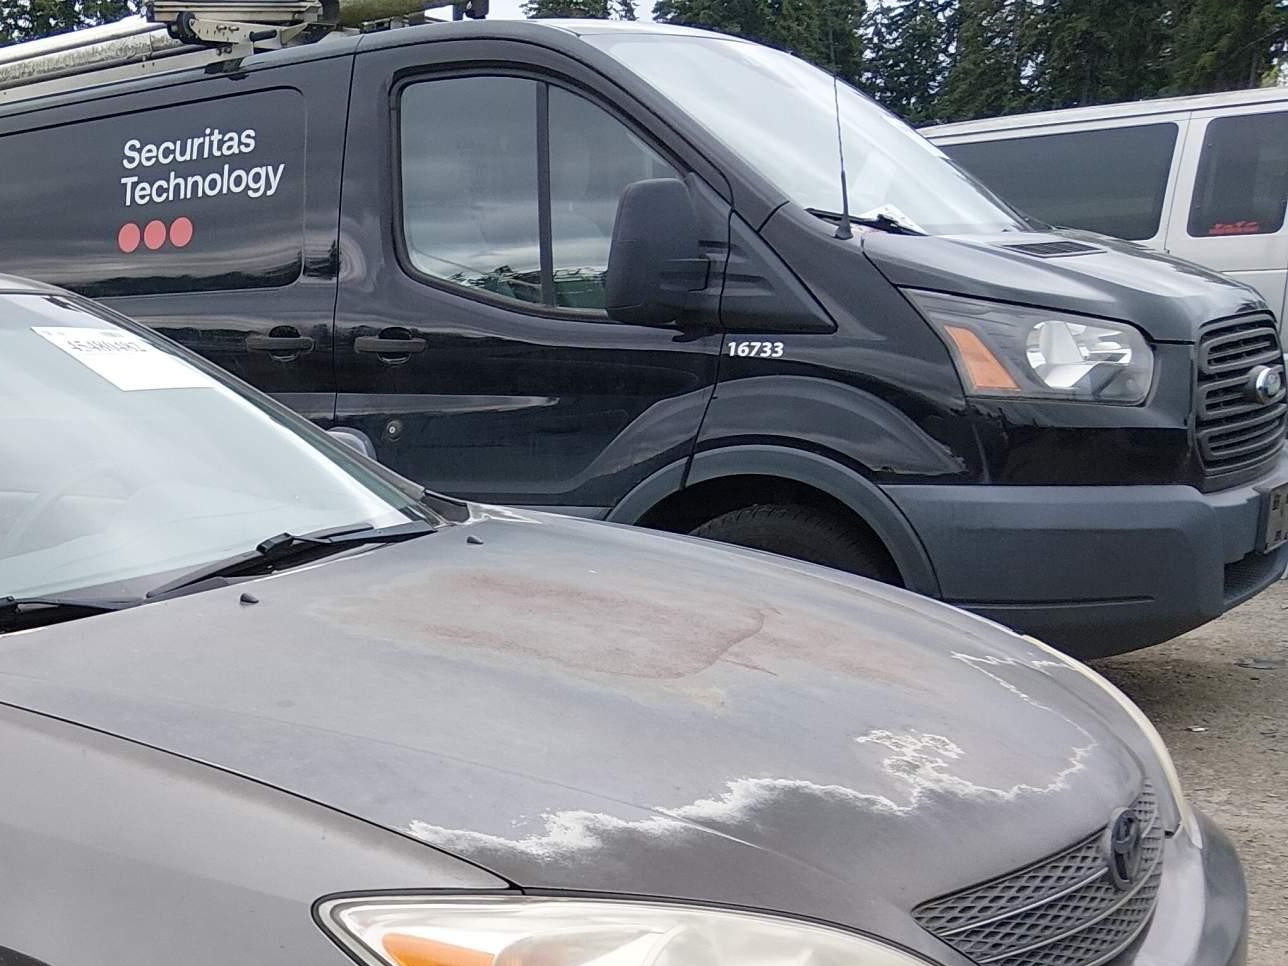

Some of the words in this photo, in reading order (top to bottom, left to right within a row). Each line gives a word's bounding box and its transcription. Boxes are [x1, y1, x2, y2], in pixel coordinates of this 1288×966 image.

[122, 127, 257, 169] Securitas
[120, 163, 286, 207] Technology
[727, 341, 785, 358] 16733
